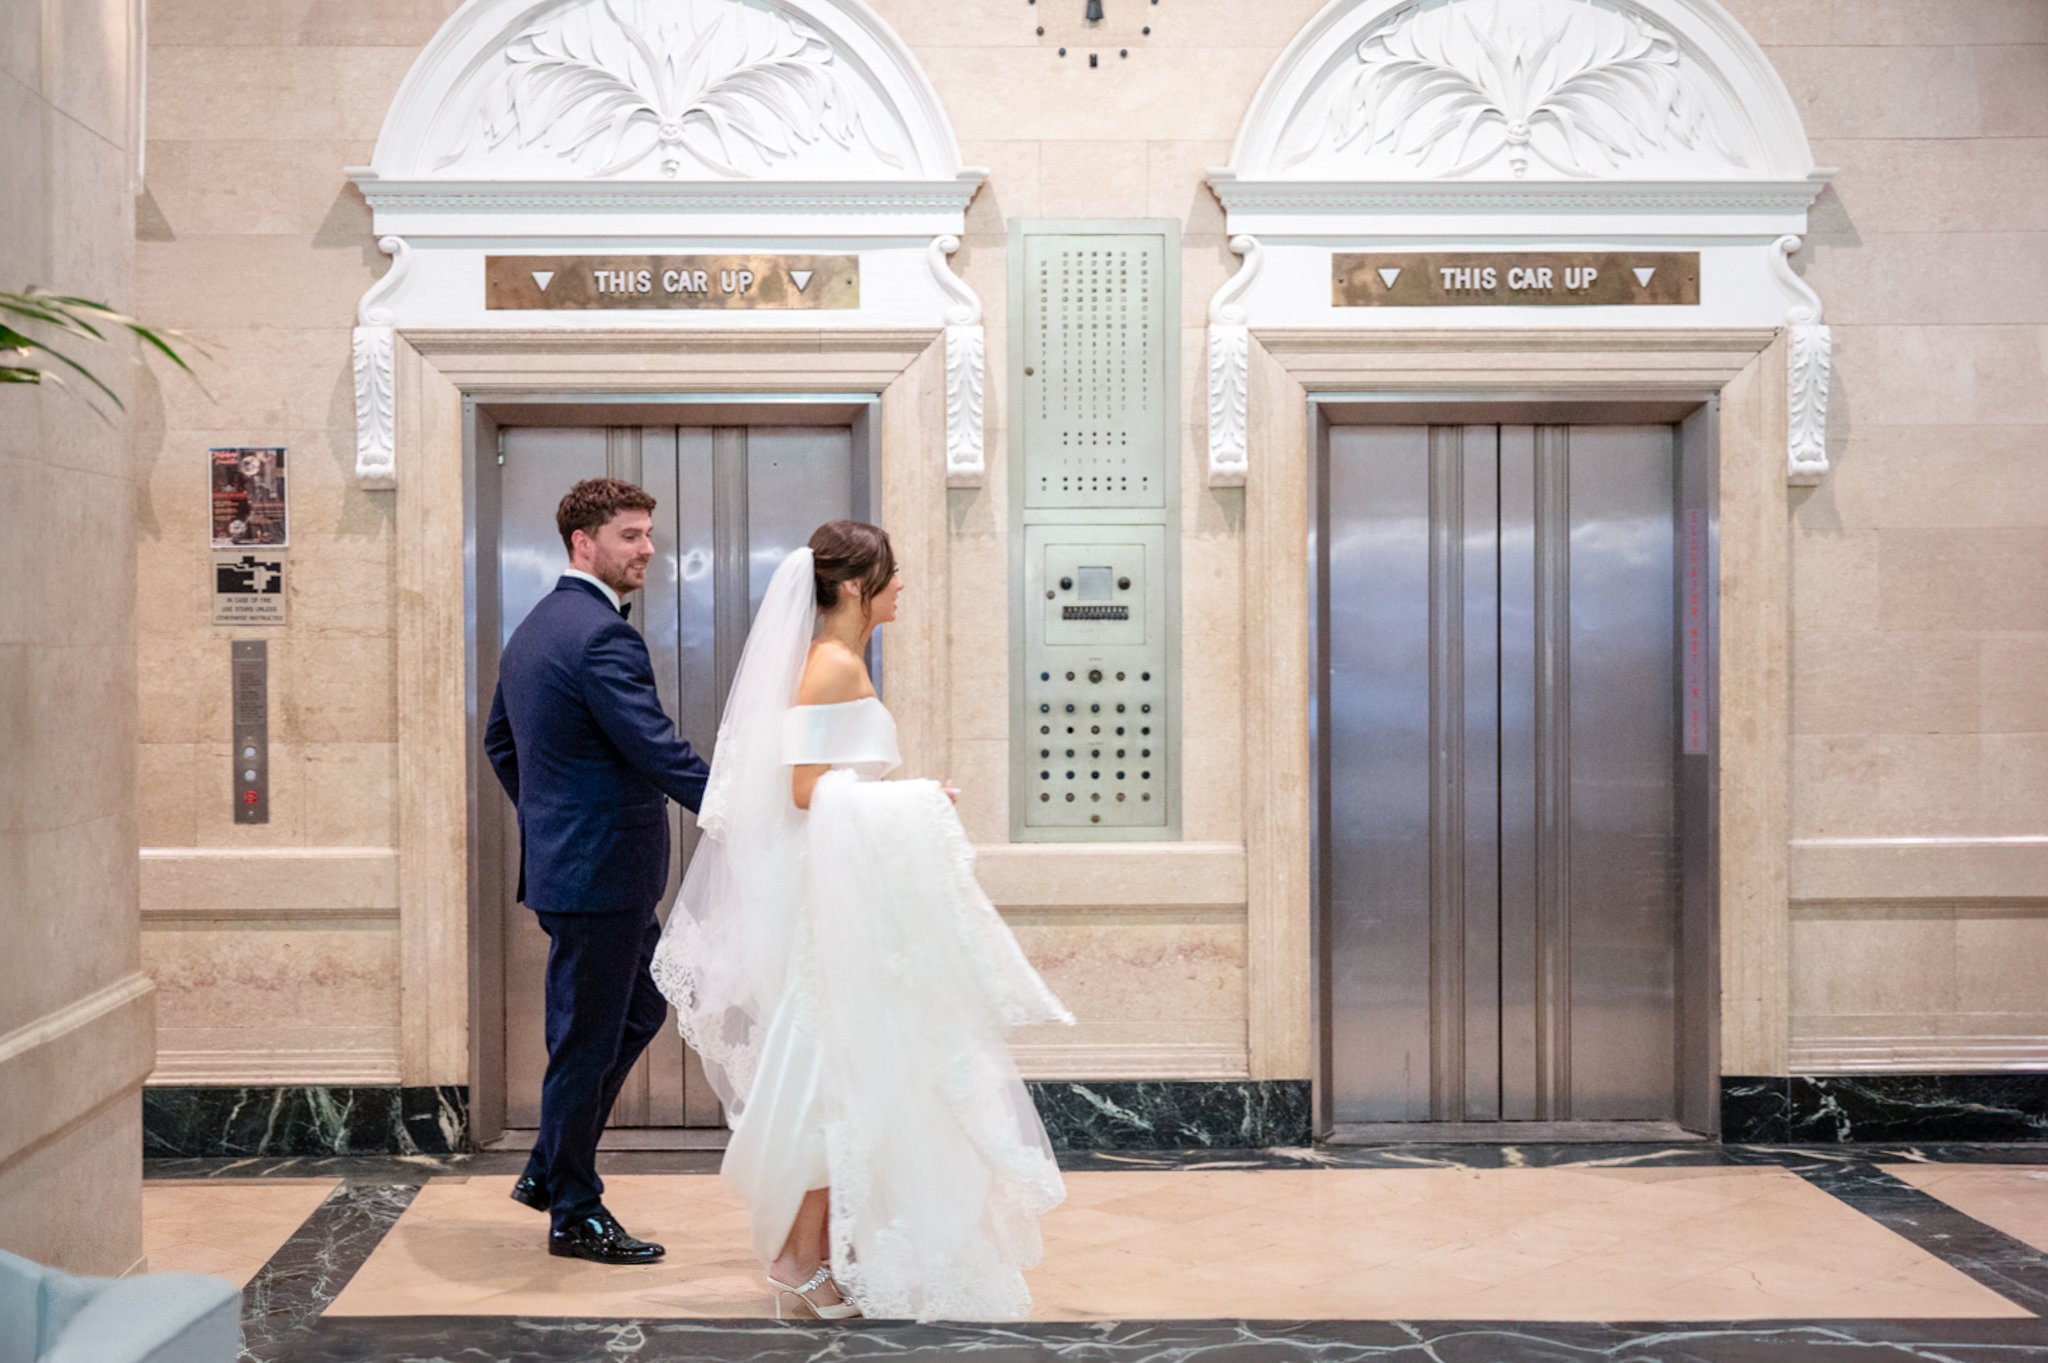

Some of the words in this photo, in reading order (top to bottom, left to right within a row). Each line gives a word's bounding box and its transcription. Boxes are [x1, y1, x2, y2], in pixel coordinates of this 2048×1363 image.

[593, 270, 652, 293] THIS
[662, 270, 708, 293] CAR
[721, 270, 754, 293] UP
[1439, 267, 1497, 290] THIS
[1507, 267, 1553, 290] CAR
[1564, 267, 1598, 290] UP
